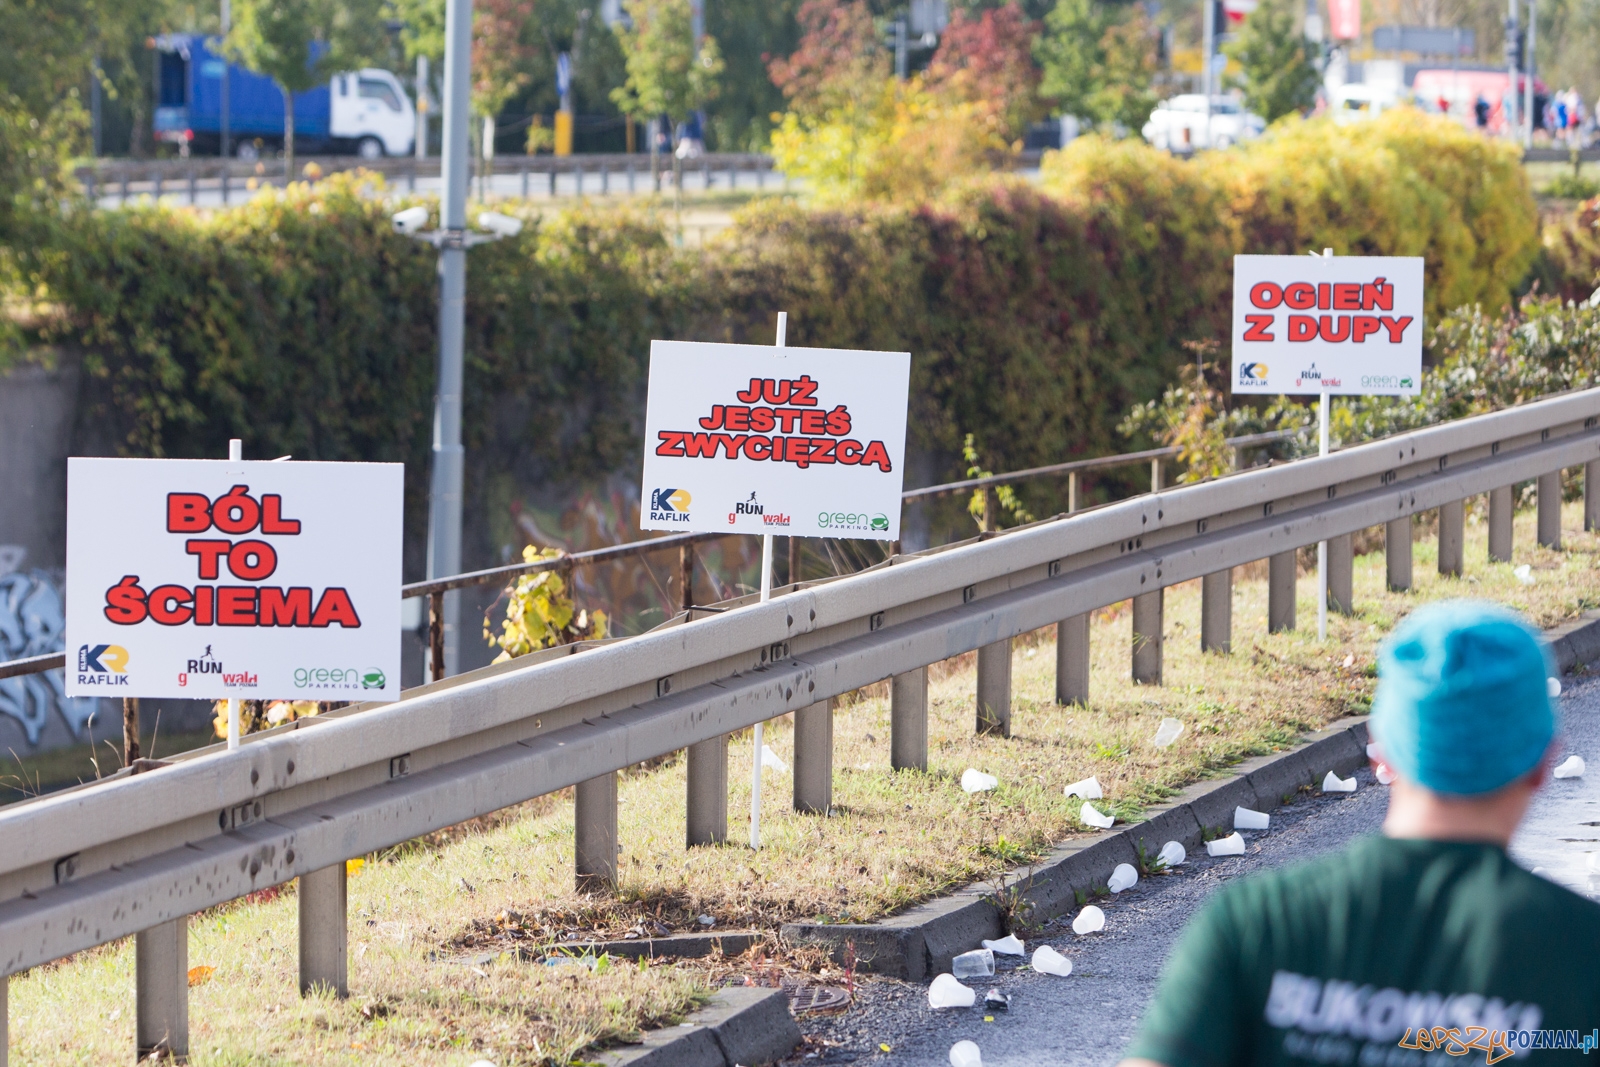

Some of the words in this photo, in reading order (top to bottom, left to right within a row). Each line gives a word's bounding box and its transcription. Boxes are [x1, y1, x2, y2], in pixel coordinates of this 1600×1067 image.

[1249, 277, 1394, 311] OGIEŃ
[1243, 314, 1275, 342] Z
[1287, 315, 1414, 344] DUPY
[737, 375, 818, 406] JUŻ
[1361, 375, 1398, 388] green
[698, 404, 852, 436] JESTEŚ
[655, 430, 892, 473] ZWYCIĘZCĄ
[167, 484, 301, 535] BÓL
[650, 512, 691, 522] RAFLIK
[818, 511, 868, 528] green
[186, 539, 278, 582] TO
[104, 575, 361, 628] ŚCIEMA
[79, 649, 87, 671] KLIMA
[78, 674, 129, 685] RAFLIK
[294, 667, 359, 689] green
